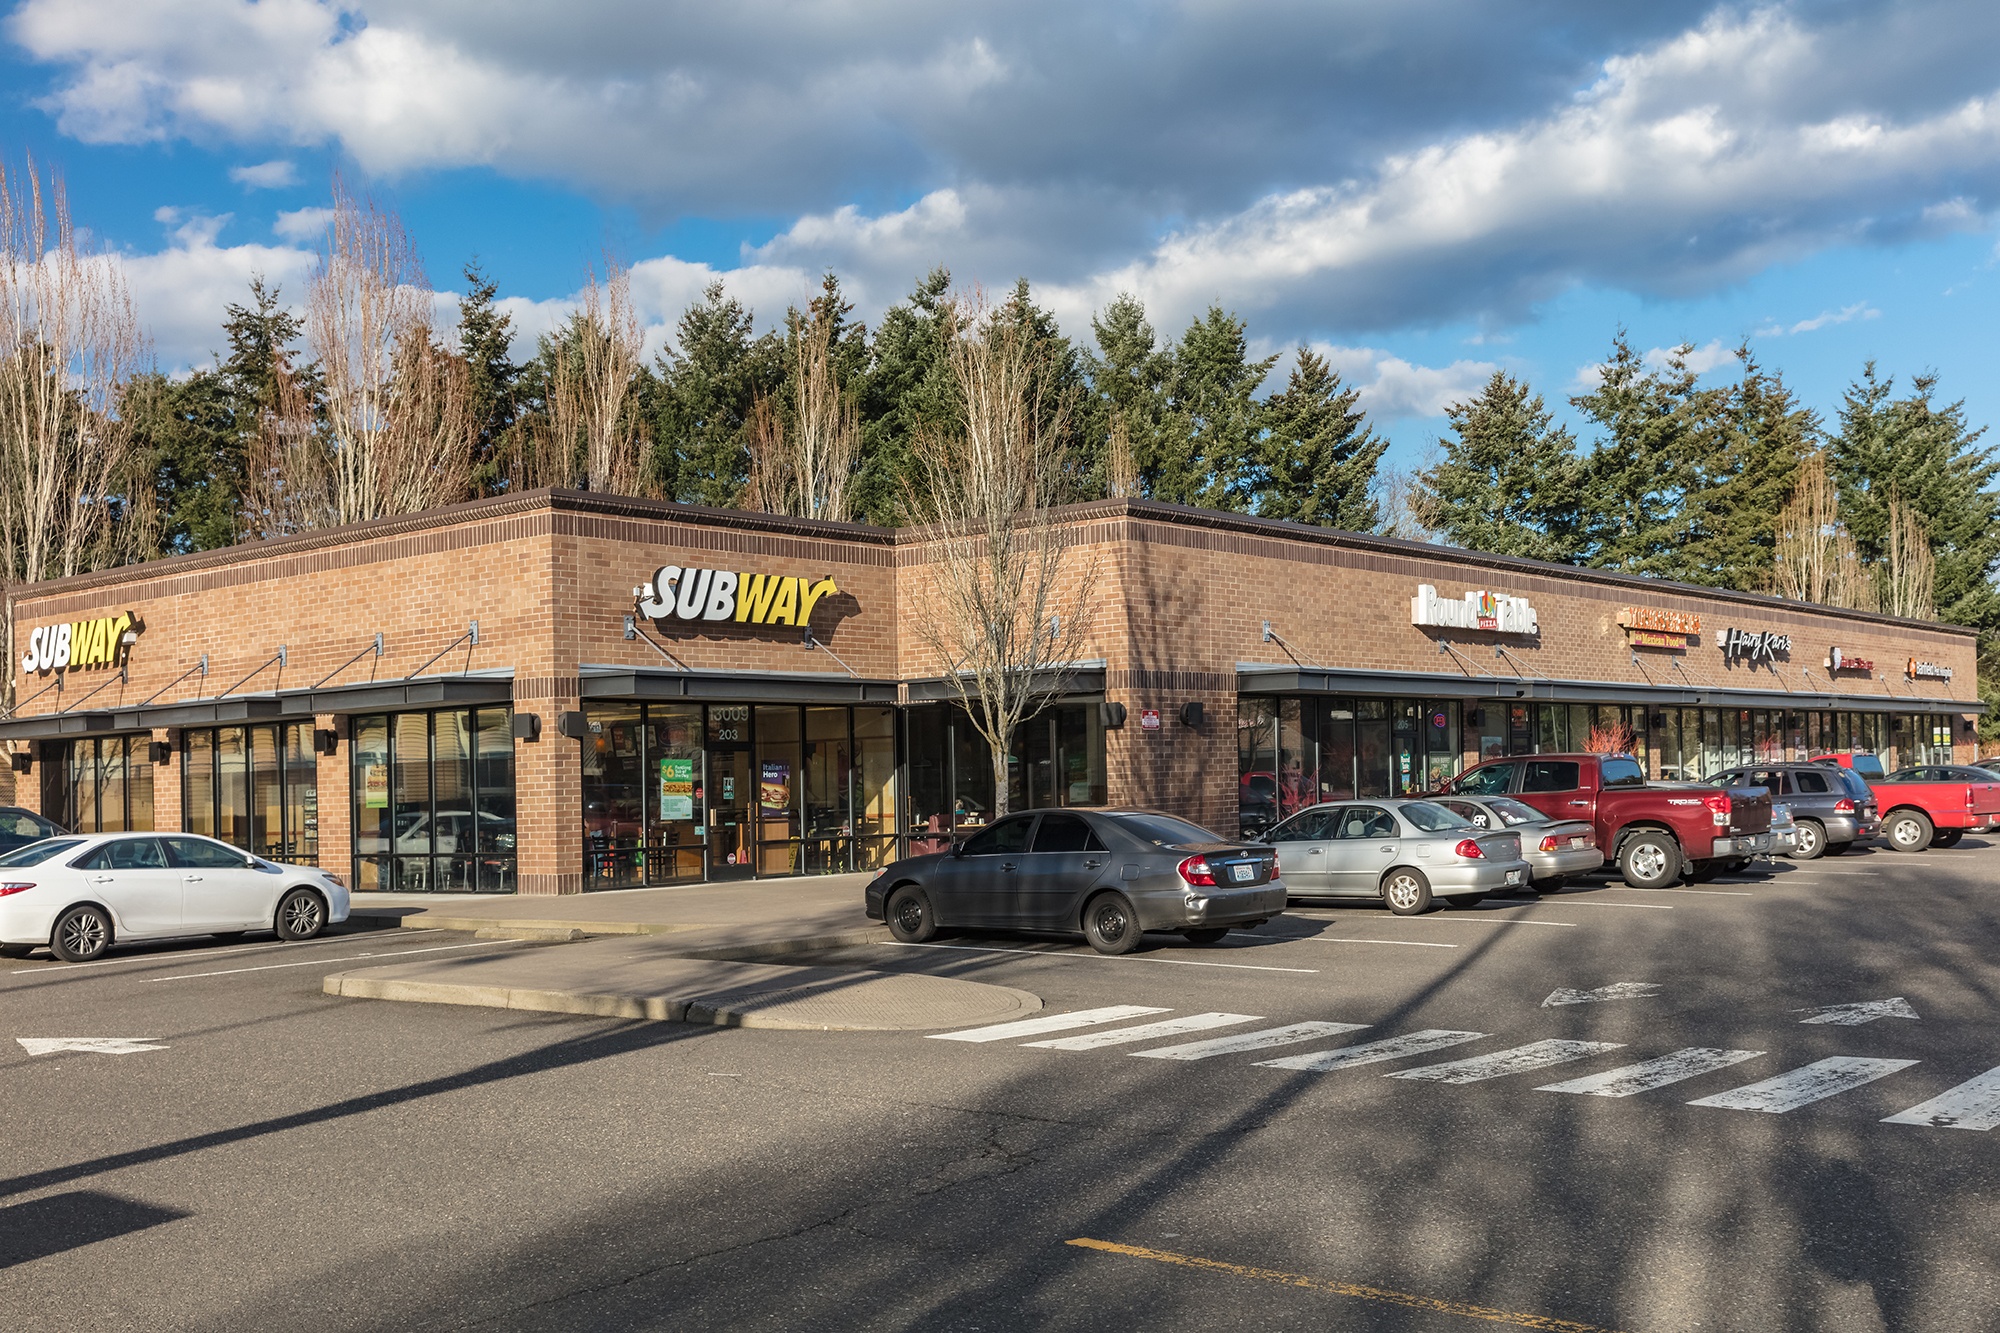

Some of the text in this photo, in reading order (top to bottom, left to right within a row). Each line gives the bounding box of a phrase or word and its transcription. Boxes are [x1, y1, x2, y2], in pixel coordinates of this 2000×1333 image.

[640, 565, 838, 627] SUBWAY
[1418, 584, 1538, 634] Round Table
[1480, 619, 1497, 628] PIZZA
[21, 611, 132, 673] SUBWAY
[1641, 632, 1679, 647] Mexican Food
[1729, 628, 1792, 661] Hairy Kari's
[719, 729, 738, 740] 203
[662, 765, 675, 778] $6
